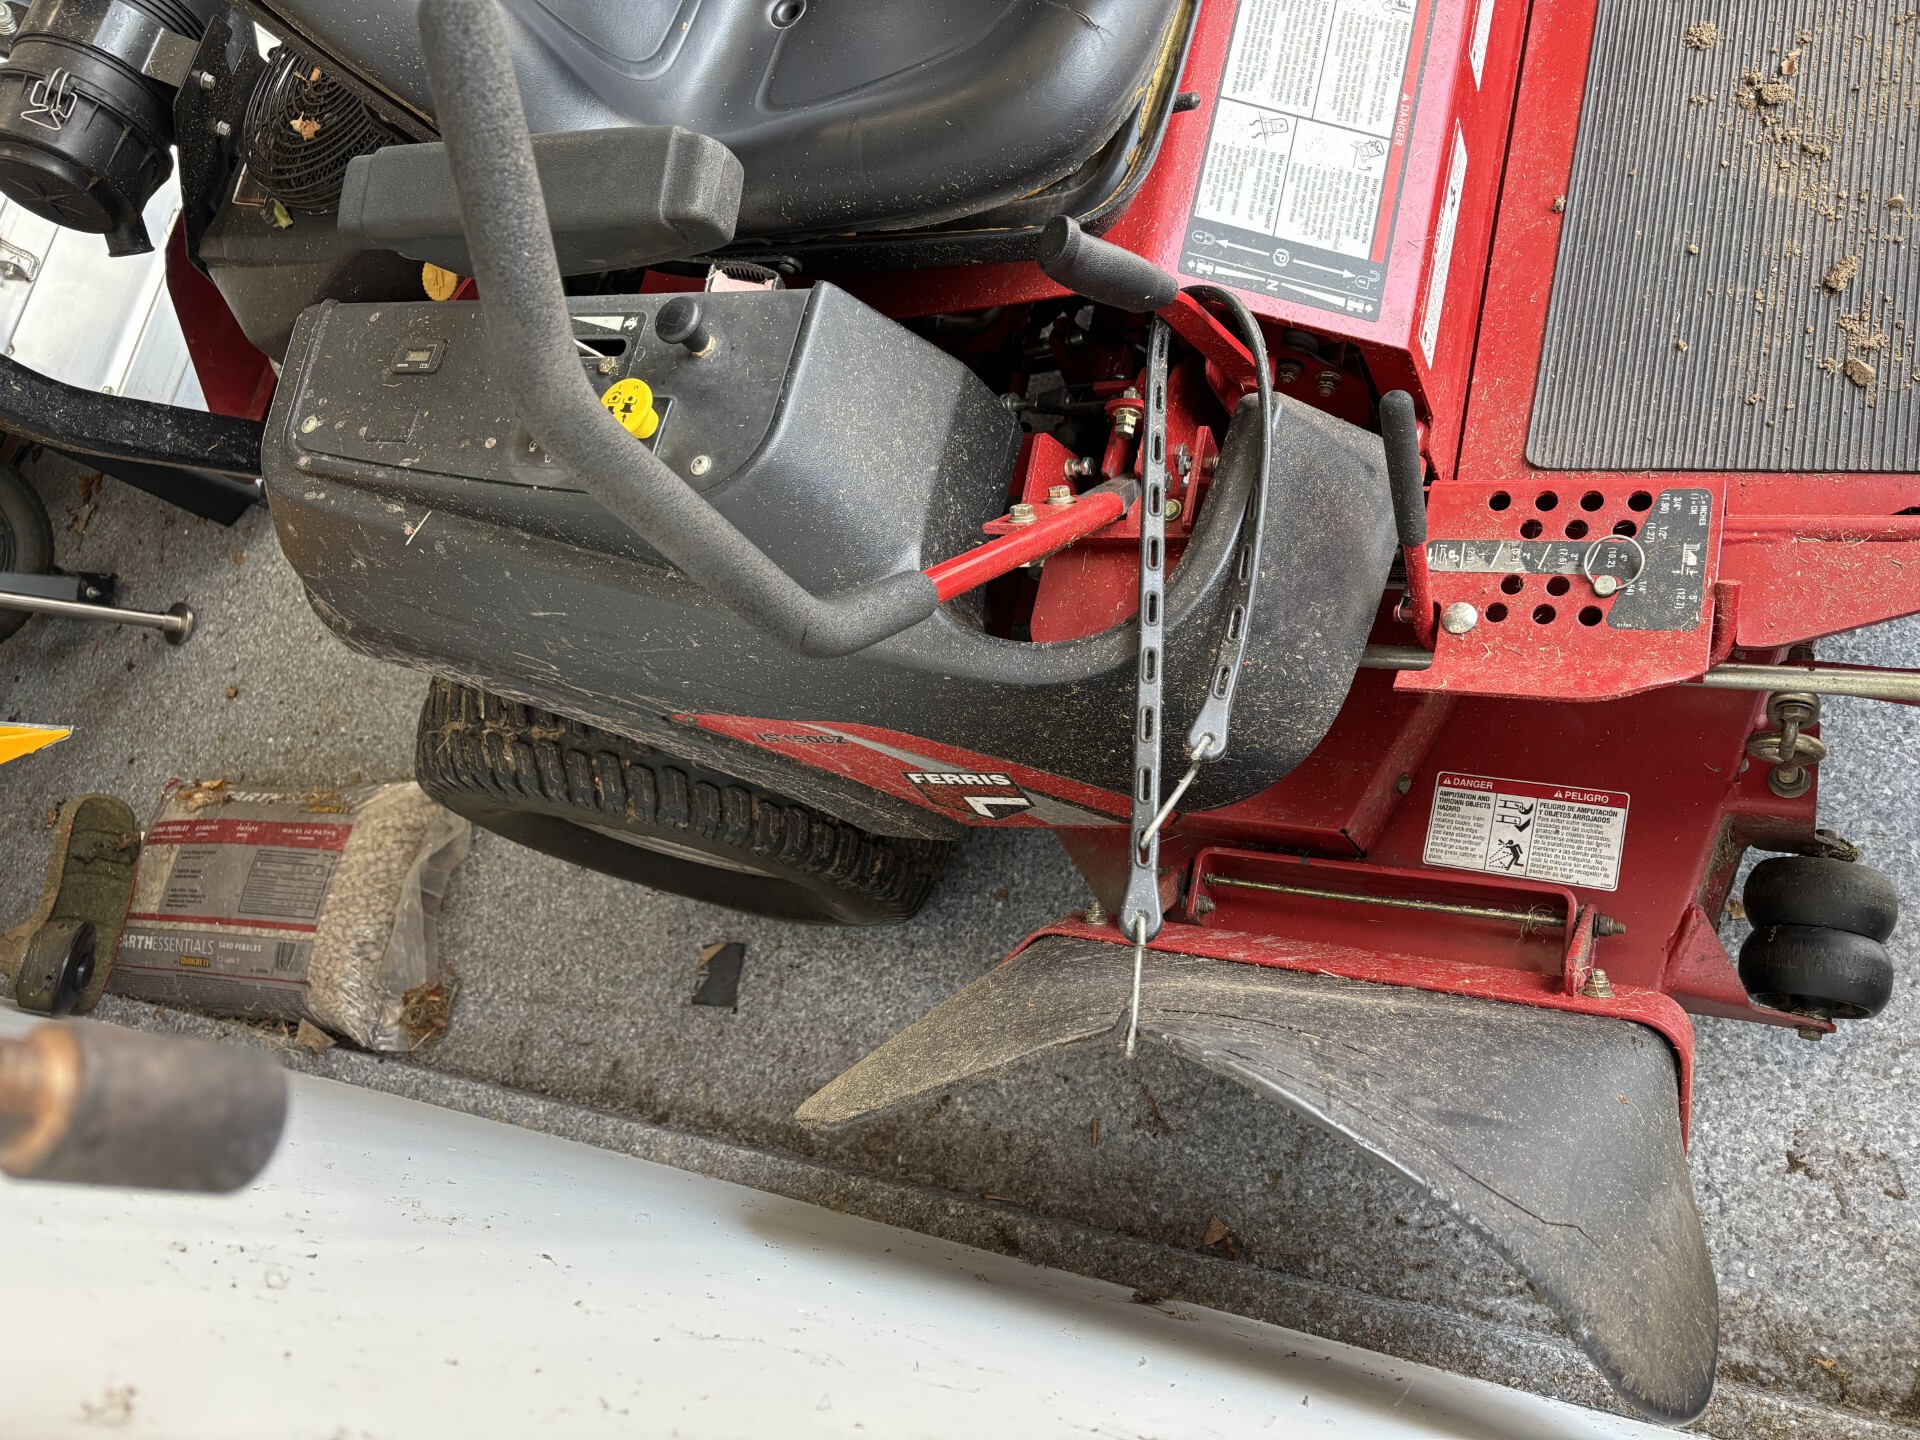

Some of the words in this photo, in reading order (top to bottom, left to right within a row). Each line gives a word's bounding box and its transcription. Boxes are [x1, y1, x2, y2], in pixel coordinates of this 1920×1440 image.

[1321, 1, 1329, 16] Loss
[1315, 24, 1324, 46] control
[1389, 18, 1400, 42] Rotating
[1396, 20, 1409, 56] Amputation
[1387, 43, 1395, 61] blades
[1307, 59, 1317, 84] roll-over
[1394, 56, 1402, 77] hazard
[1302, 85, 1311, 107] hazard
[1374, 108, 1383, 123] legs.
[1393, 103, 1409, 146] DANGER
[1268, 151, 1276, 163] Wet
[1253, 167, 1263, 187] sliding
[1264, 171, 1272, 183] soft
[1272, 175, 1280, 188] soft
[1352, 173, 1361, 195] Wheels
[1251, 187, 1259, 199] and
[1258, 183, 1269, 203] slopes
[1369, 177, 1378, 197] Water,
[1267, 188, 1277, 206] slope
[1356, 188, 1367, 214] drop-off
[1248, 200, 1256, 212] loss
[1345, 196, 1357, 222] dropping
[1363, 198, 1375, 226] retaining
[1264, 207, 1274, 229] hazard
[1353, 214, 1362, 240] hazards
[1361, 227, 1369, 244] walls
[1265, 277, 1279, 291] N
[1660, 494, 1670, 513] (1.90)
[1673, 497, 1683, 510] 3/4"
[1690, 505, 1698, 515] CM
[1698, 506, 1708, 526] INCHES
[1645, 522, 1656, 543] (1.27)
[1658, 526, 1668, 539] 1/2"
[1558, 548, 1568, 565] (7.6)
[1606, 548, 1617, 568] (10.2)
[1638, 581, 1647, 594] 1/4"
[1674, 588, 1686, 609] (12.7)
[755, 733, 780, 742] IS
[780, 734, 850, 744] 1500Z
[908, 773, 1012, 786] FERRIS
[1452, 777, 1493, 789] DANGER
[1438, 797, 1464, 805] THROWN
[1464, 800, 1490, 809] OBJECTS
[1439, 790, 1476, 800] AMPUTATION
[1564, 790, 1609, 803] PELIGRO
[1437, 804, 1460, 812] HAZARD
[1539, 802, 1565, 811] PELIGRO
[1576, 806, 1617, 817] AMPUTACIÓN
[1544, 810, 1571, 819] OBJETOS
[1572, 813, 1610, 824] ARROJADOS
[121, 934, 214, 955] ARTHESSENTIALS
[218, 941, 234, 950] SAND
[235, 943, 262, 952] PEBBLES
[180, 957, 210, 967] QUIKRETE
